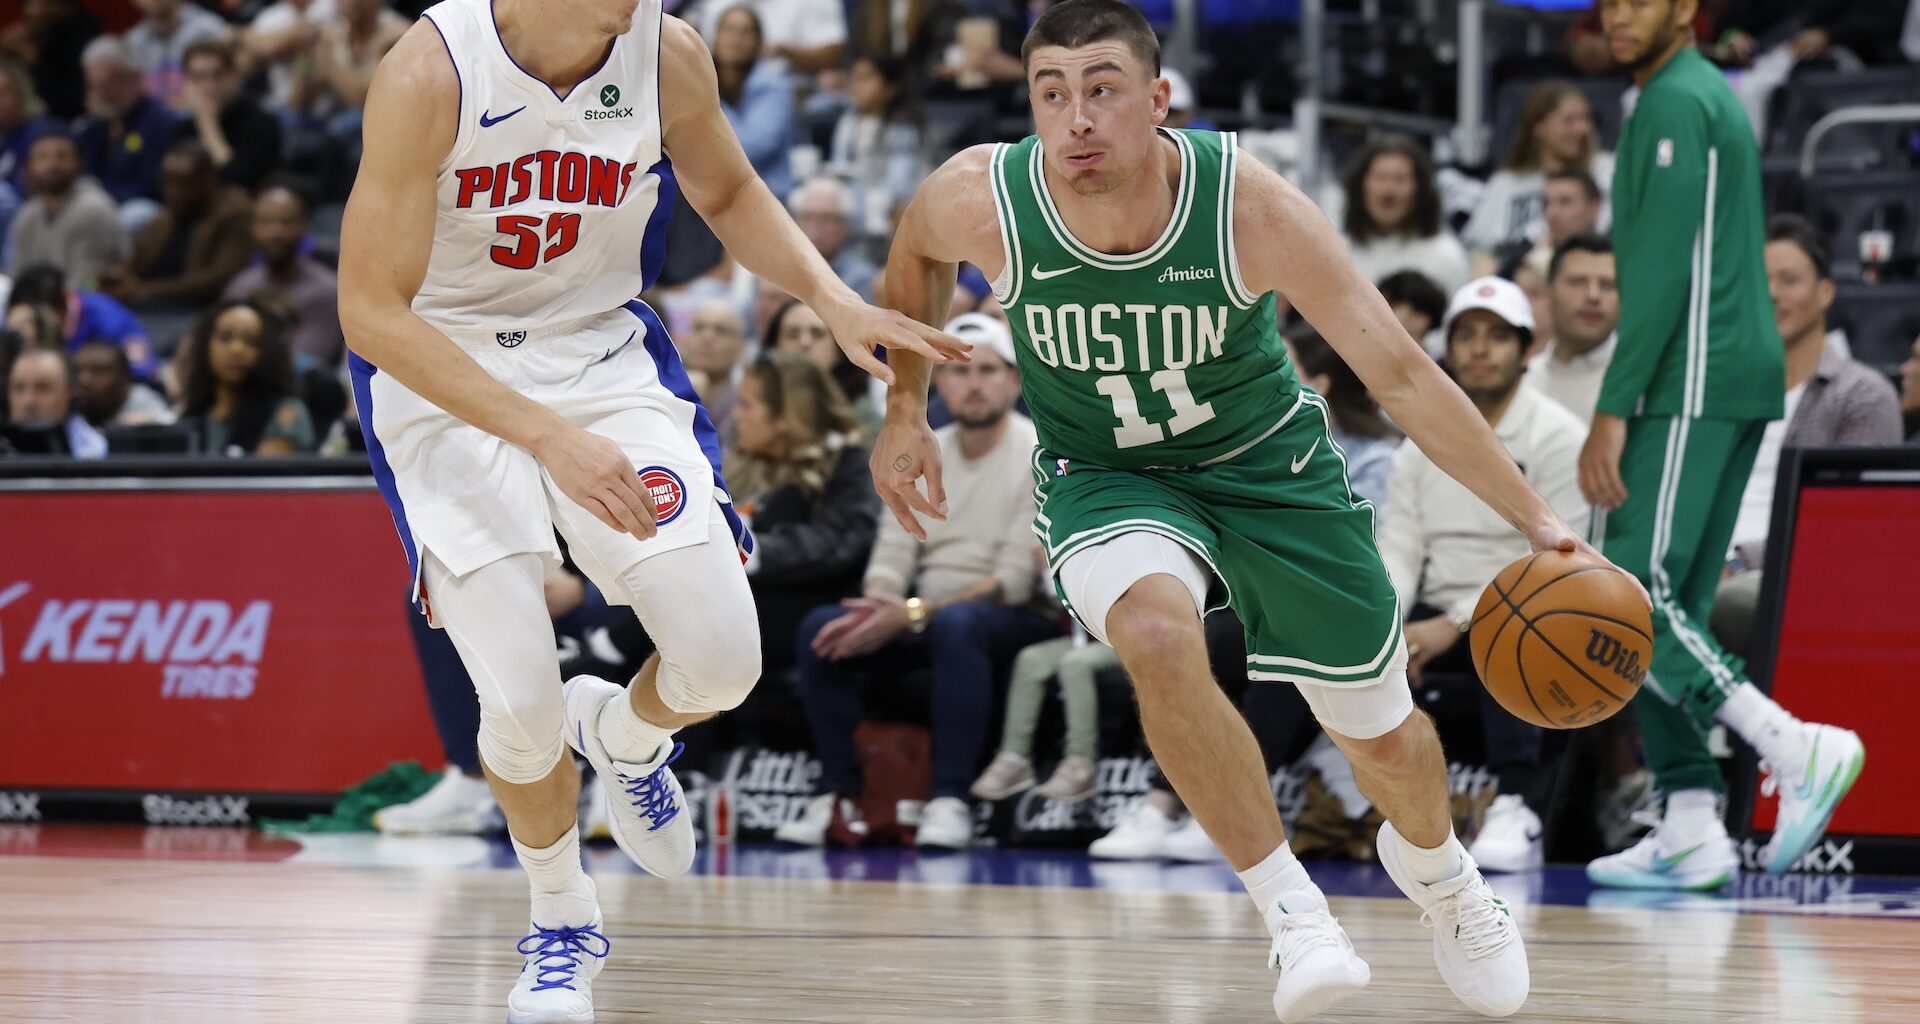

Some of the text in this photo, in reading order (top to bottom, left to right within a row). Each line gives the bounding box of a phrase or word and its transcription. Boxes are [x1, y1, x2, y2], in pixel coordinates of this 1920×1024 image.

[584, 107, 633, 120] StockX
[455, 150, 638, 208] PISTONS
[1158, 266, 1215, 283] Amica
[1024, 303, 1228, 372] BOSTON
[1095, 369, 1216, 449] 11
[648, 483, 673, 497] TROIT
[653, 492, 676, 506] TONS
[20, 599, 272, 663] KENDA
[1585, 626, 1647, 687] Wilso
[161, 666, 258, 699] TIRES
[142, 793, 250, 825] StockX
